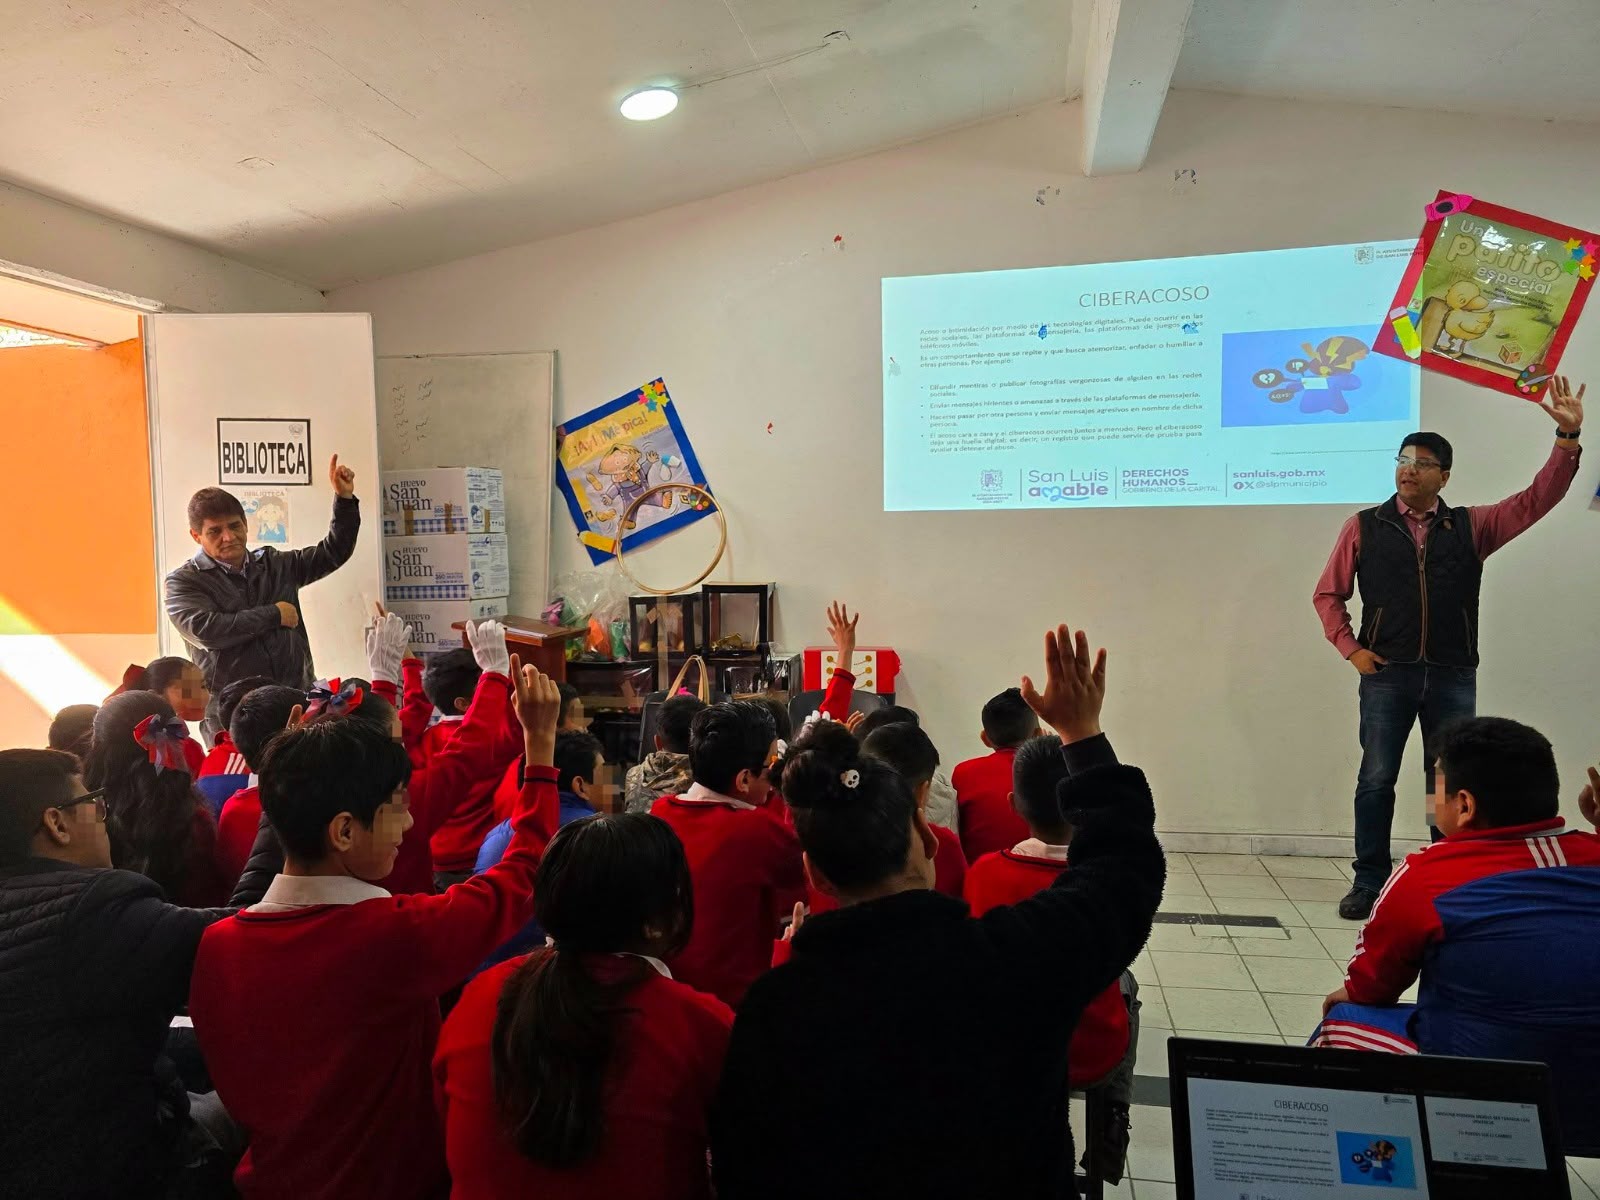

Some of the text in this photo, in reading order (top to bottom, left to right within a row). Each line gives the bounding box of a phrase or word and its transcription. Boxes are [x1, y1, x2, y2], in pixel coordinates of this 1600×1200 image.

[1460, 220, 1484, 237] Un
[1446, 234, 1562, 282] patito
[1477, 266, 1552, 295] especial
[1079, 286, 1209, 307] CIBERACOSO
[622, 411, 648, 433] pica!
[222, 442, 306, 474] BIBLIOTECA
[1029, 469, 1108, 482] San Luis
[1122, 469, 1189, 478] DERECHOS
[1233, 468, 1325, 478] sanluis.gob.mx
[390, 484, 420, 500] San
[1029, 483, 1108, 502] amable
[1256, 480, 1327, 489] @slpmunicipio
[394, 498, 432, 513] Juan
[392, 550, 422, 566] San
[393, 565, 433, 581] Juan
[405, 620, 424, 632] an
[408, 632, 436, 643] uan
[1274, 1100, 1329, 1112] CIBERACOSO
